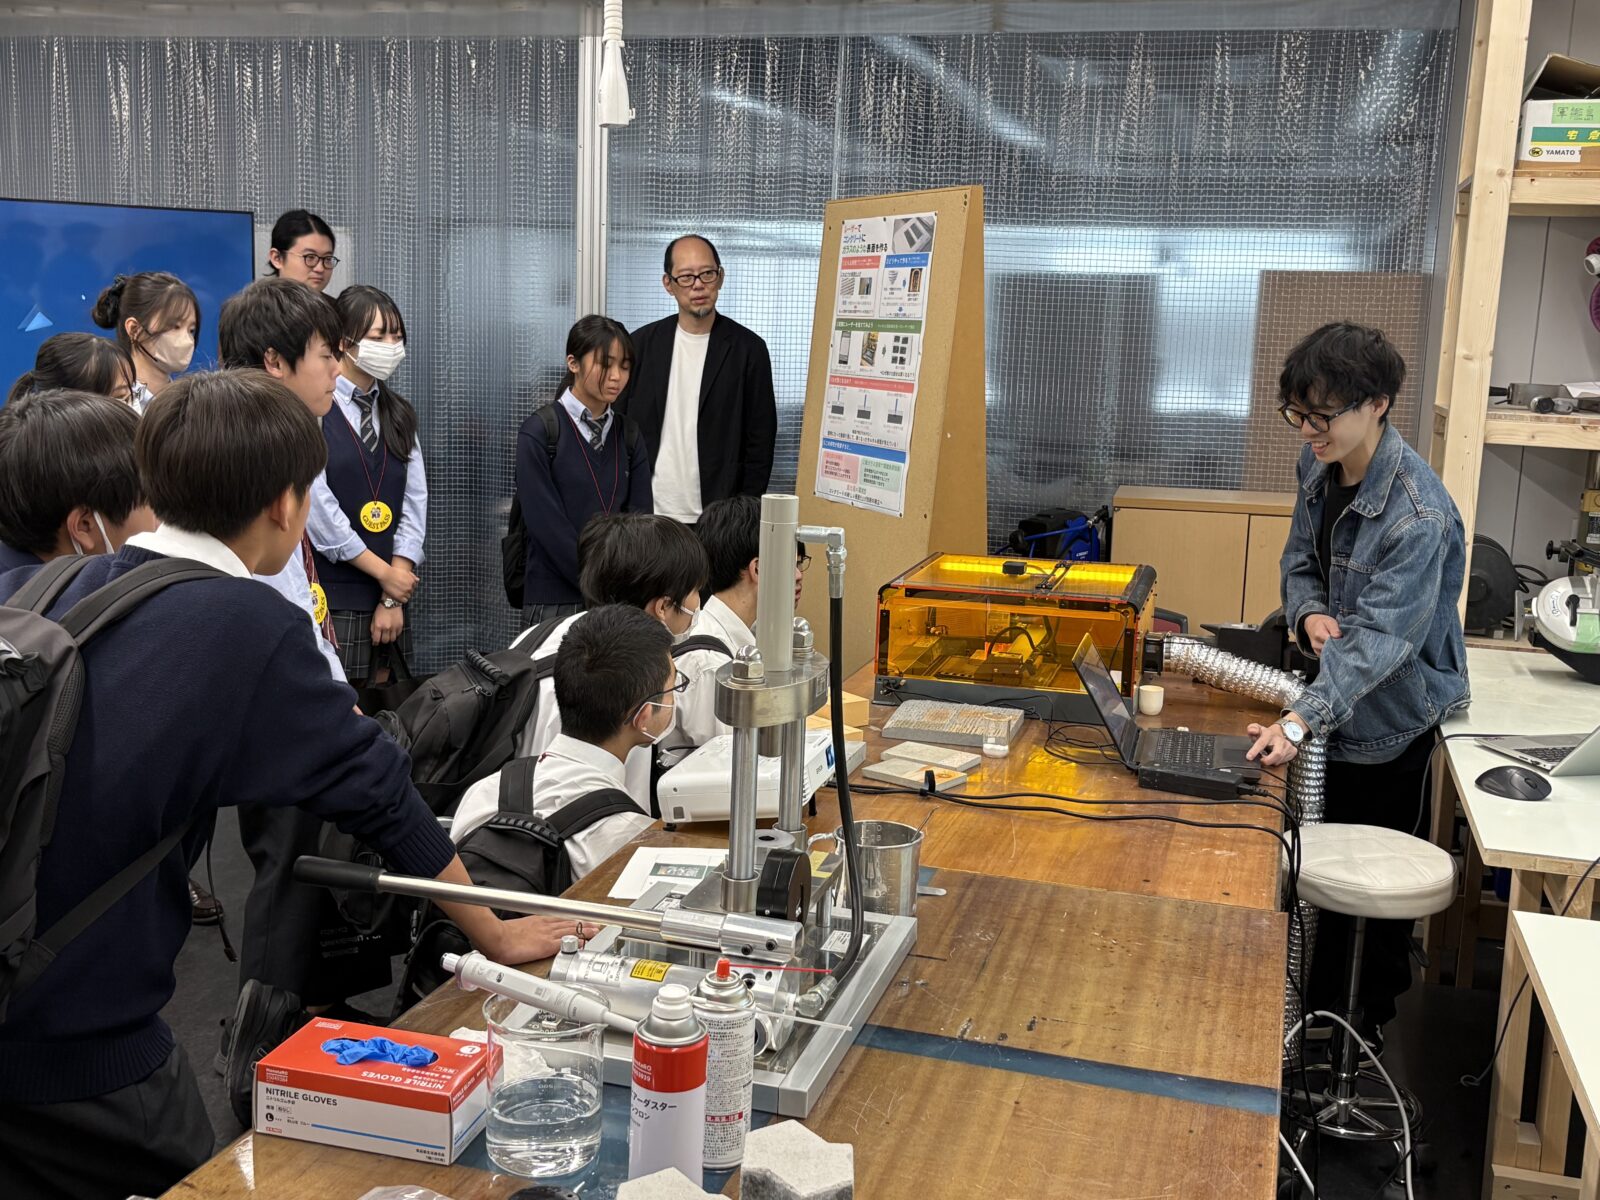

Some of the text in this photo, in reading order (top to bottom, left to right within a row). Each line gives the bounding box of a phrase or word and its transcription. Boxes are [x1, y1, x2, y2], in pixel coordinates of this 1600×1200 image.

[843, 233, 866, 243] コンクリートに
[362, 513, 391, 530] GUEST PASS
[360, 1070, 445, 1089] NITRILE GLOVES
[265, 1087, 338, 1106] NITRILE GLOVES
[632, 1090, 678, 1111] アーダスター
